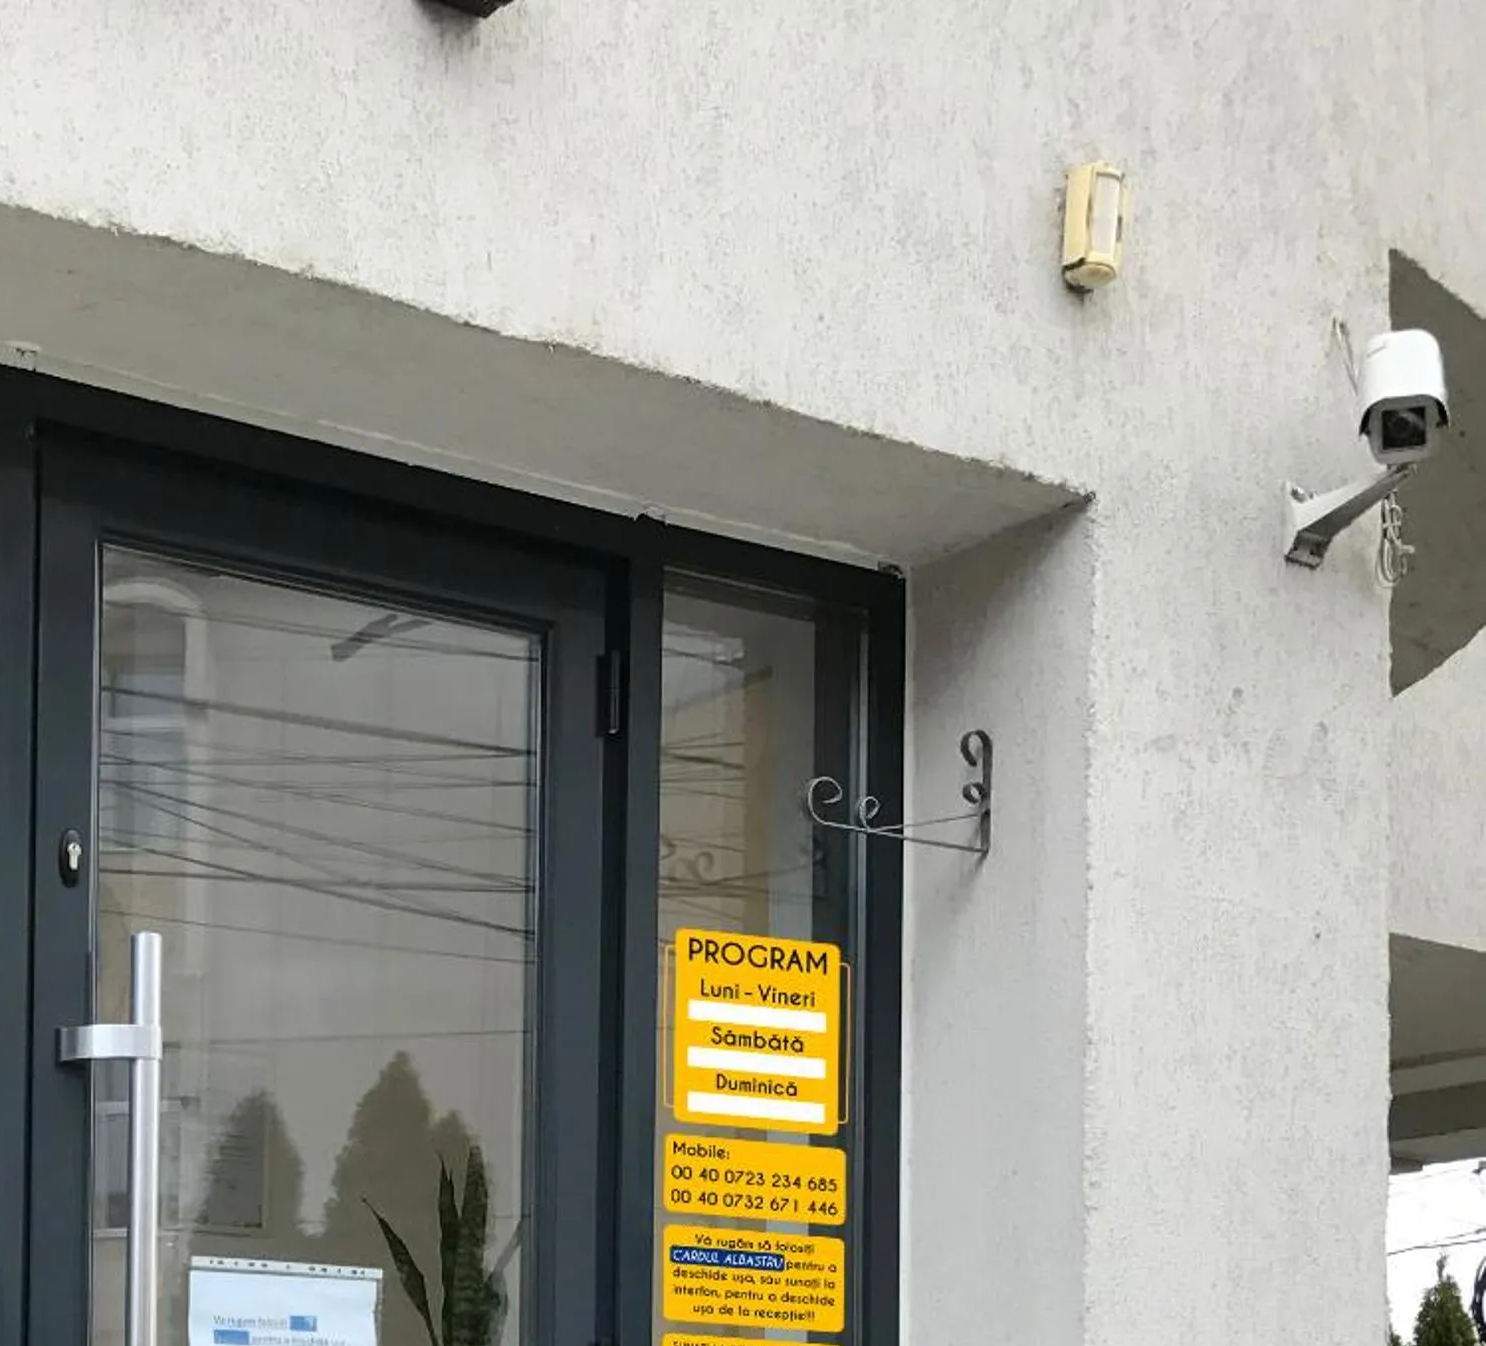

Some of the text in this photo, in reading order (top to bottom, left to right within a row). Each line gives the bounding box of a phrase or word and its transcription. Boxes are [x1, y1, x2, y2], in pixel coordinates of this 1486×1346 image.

[688, 938, 829, 975] PROGRAM
[700, 979, 740, 1000] Luni
[758, 985, 816, 1008] Vineri
[716, 1074, 798, 1098] Duminică
[672, 1140, 731, 1160] Mobile:
[671, 1165, 838, 1192] 00 40 0723 234 685
[670, 1188, 838, 1216] 00 40 0732 671 446
[673, 1249, 720, 1263] CARDUL
[724, 1253, 784, 1269] ALBASTRU
[673, 1266, 728, 1281] deschide
[760, 1275, 781, 1285] sau
[824, 1278, 835, 1289] la
[725, 1289, 763, 1301] pentru
[780, 1291, 835, 1307] deschide
[718, 1303, 734, 1315] de
[738, 1304, 750, 1317] la
